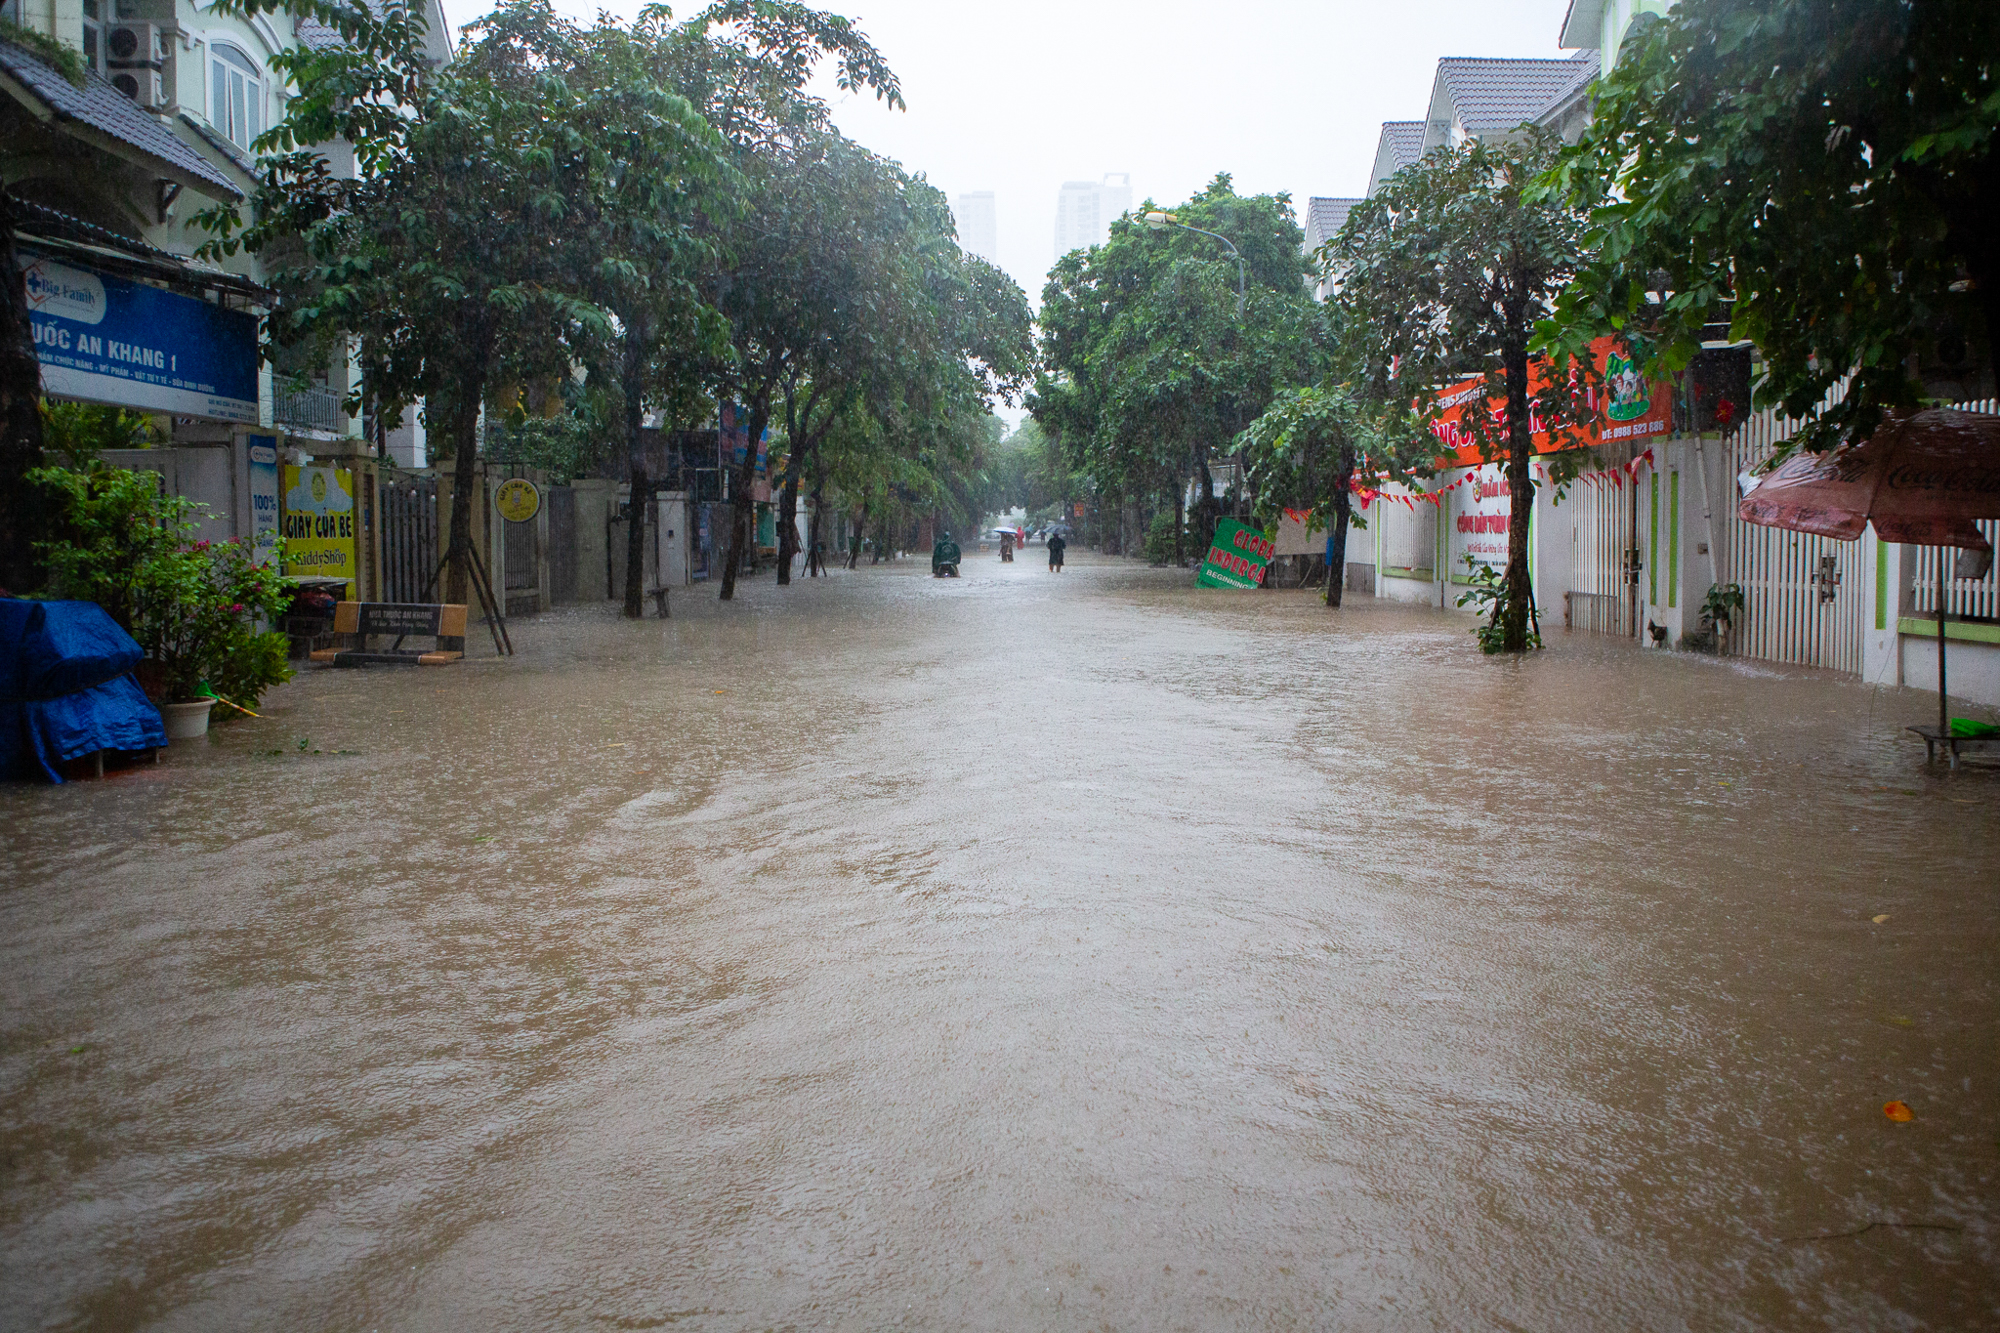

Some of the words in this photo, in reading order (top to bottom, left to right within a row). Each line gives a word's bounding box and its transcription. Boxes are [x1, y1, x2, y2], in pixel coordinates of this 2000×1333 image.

[41, 278, 60, 295] Big
[62, 284, 96, 309] Family
[77, 333, 102, 357] AN
[108, 340, 165, 370] KHANG
[171, 354, 177, 372] 1
[1613, 425, 1632, 438] 0988
[1633, 422, 1648, 435] 523
[253, 495, 277, 511] 100%
[287, 508, 312, 539] GIÀY
[315, 507, 337, 539] CỦA
[339, 509, 353, 539] BÉ
[1233, 529, 1275, 561] GLOBA
[1208, 546, 1266, 584] INDERGA
